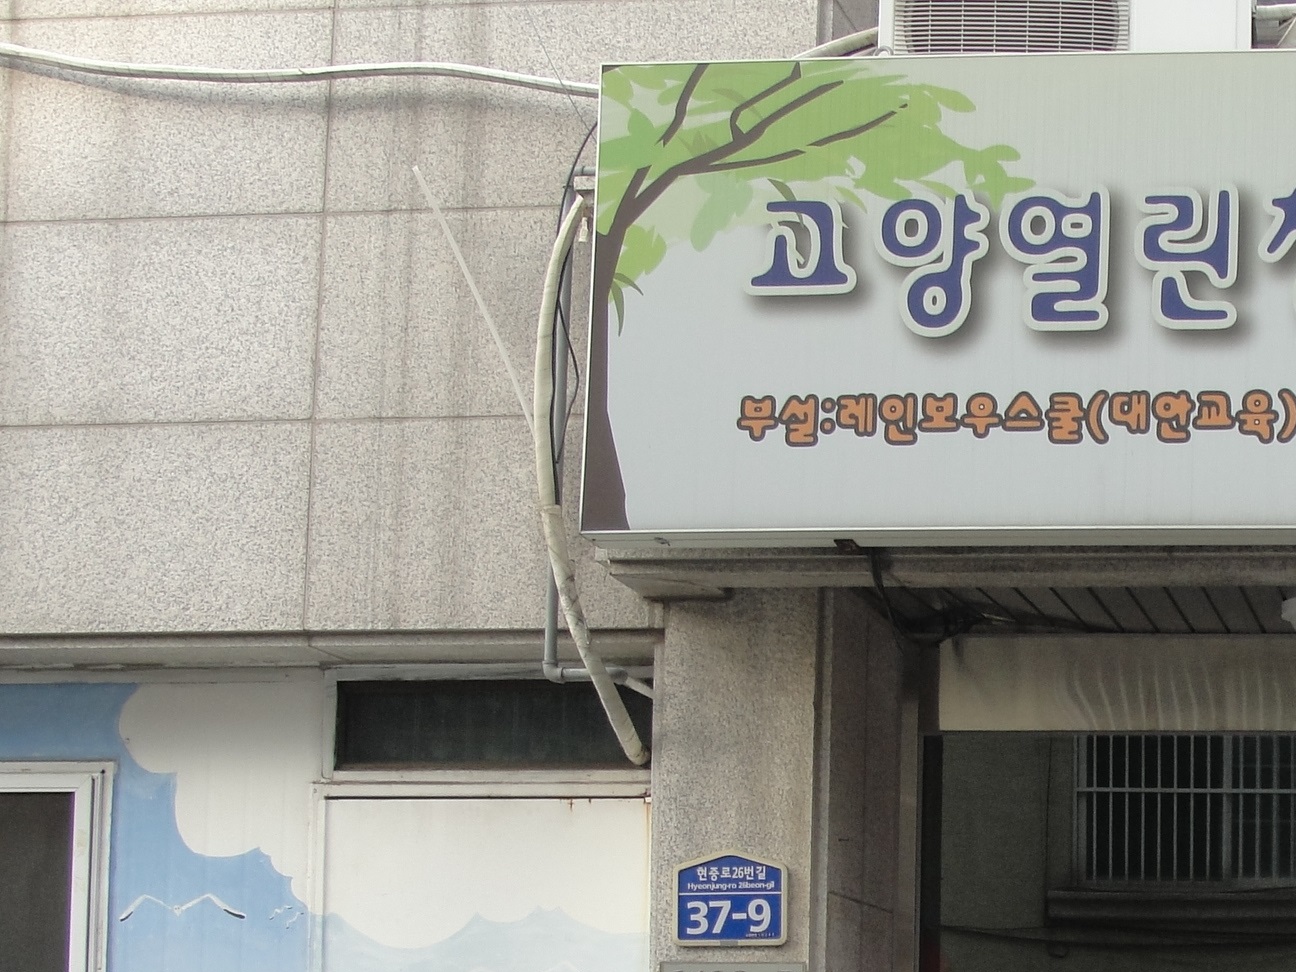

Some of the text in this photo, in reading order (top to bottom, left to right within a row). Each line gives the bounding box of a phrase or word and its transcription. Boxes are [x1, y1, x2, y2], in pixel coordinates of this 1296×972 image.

[696, 865, 767, 882] 현중로26번길
[687, 882, 737, 892] Hyeonjung-ro
[686, 899, 771, 935] 37-9
